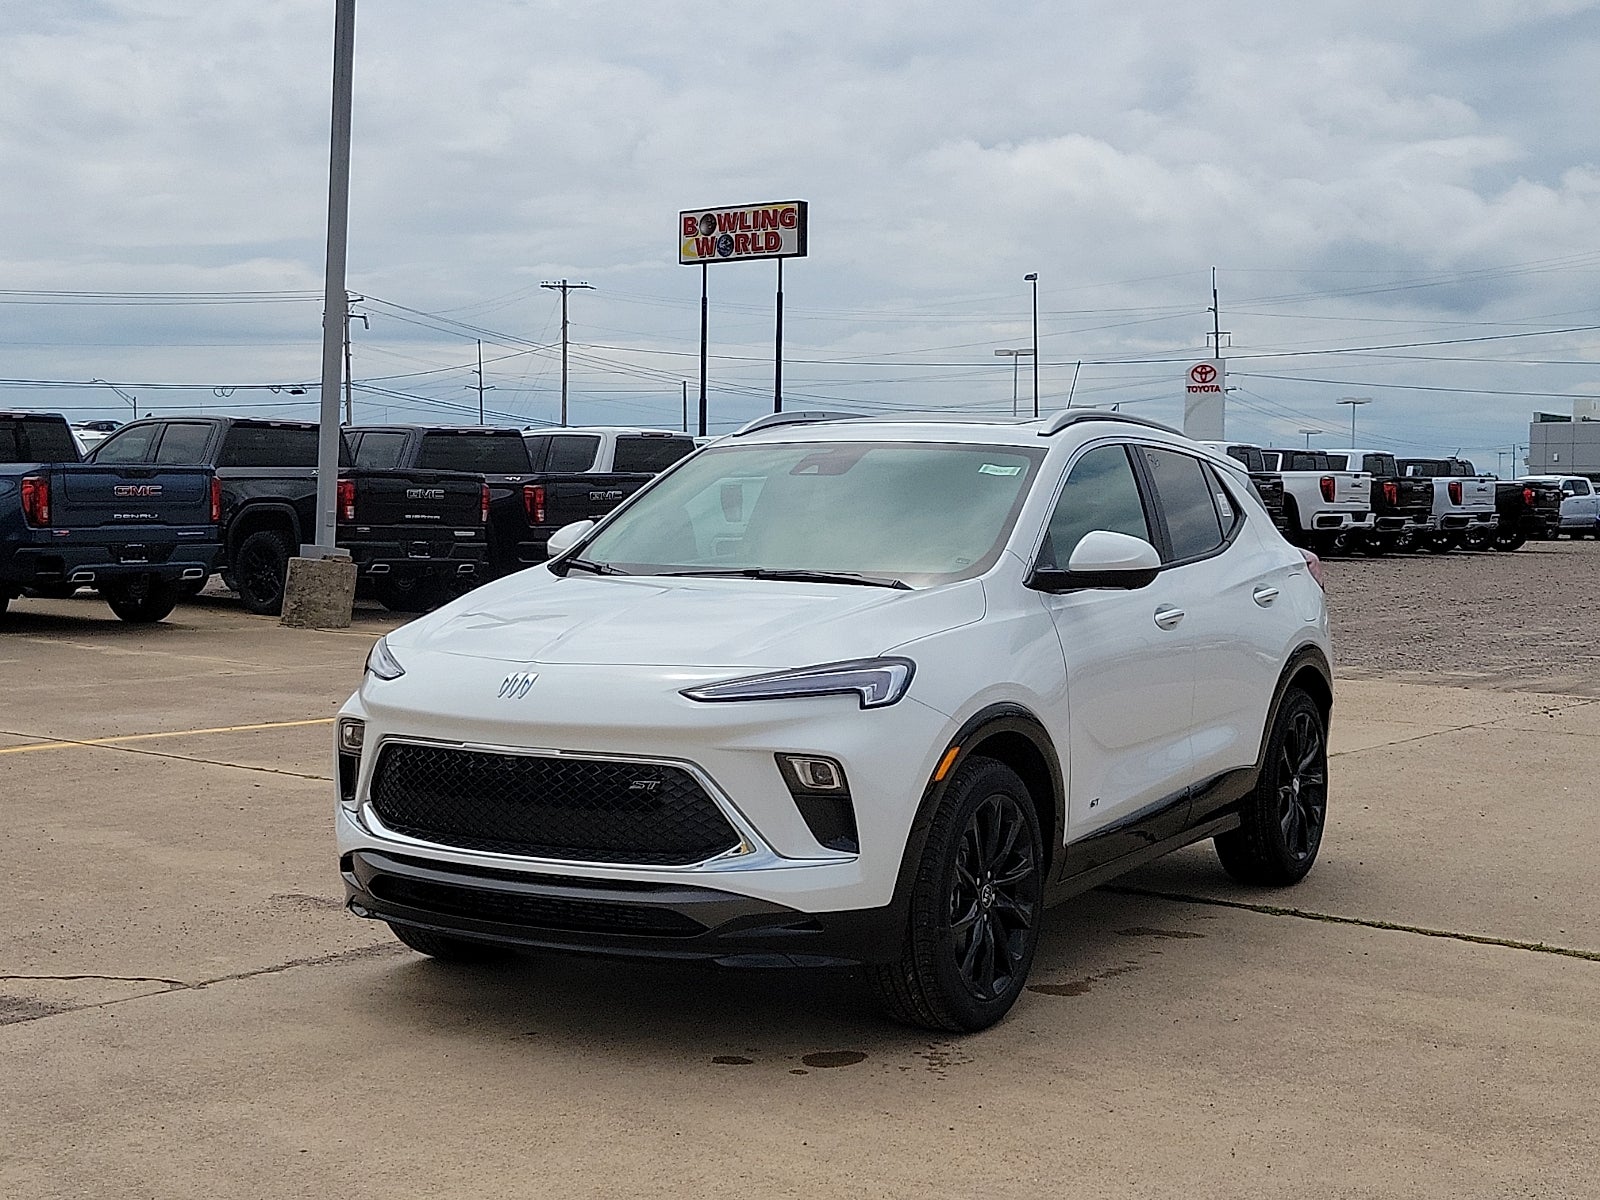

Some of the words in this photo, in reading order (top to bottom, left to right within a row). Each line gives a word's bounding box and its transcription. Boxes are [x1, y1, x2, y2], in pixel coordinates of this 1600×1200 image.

[683, 208, 797, 235] BOWLING
[695, 231, 782, 257] WORLD
[1186, 384, 1221, 394] TOYOTA
[114, 485, 163, 497] GMC
[406, 489, 445, 500] GMC
[589, 490, 623, 501] GMC
